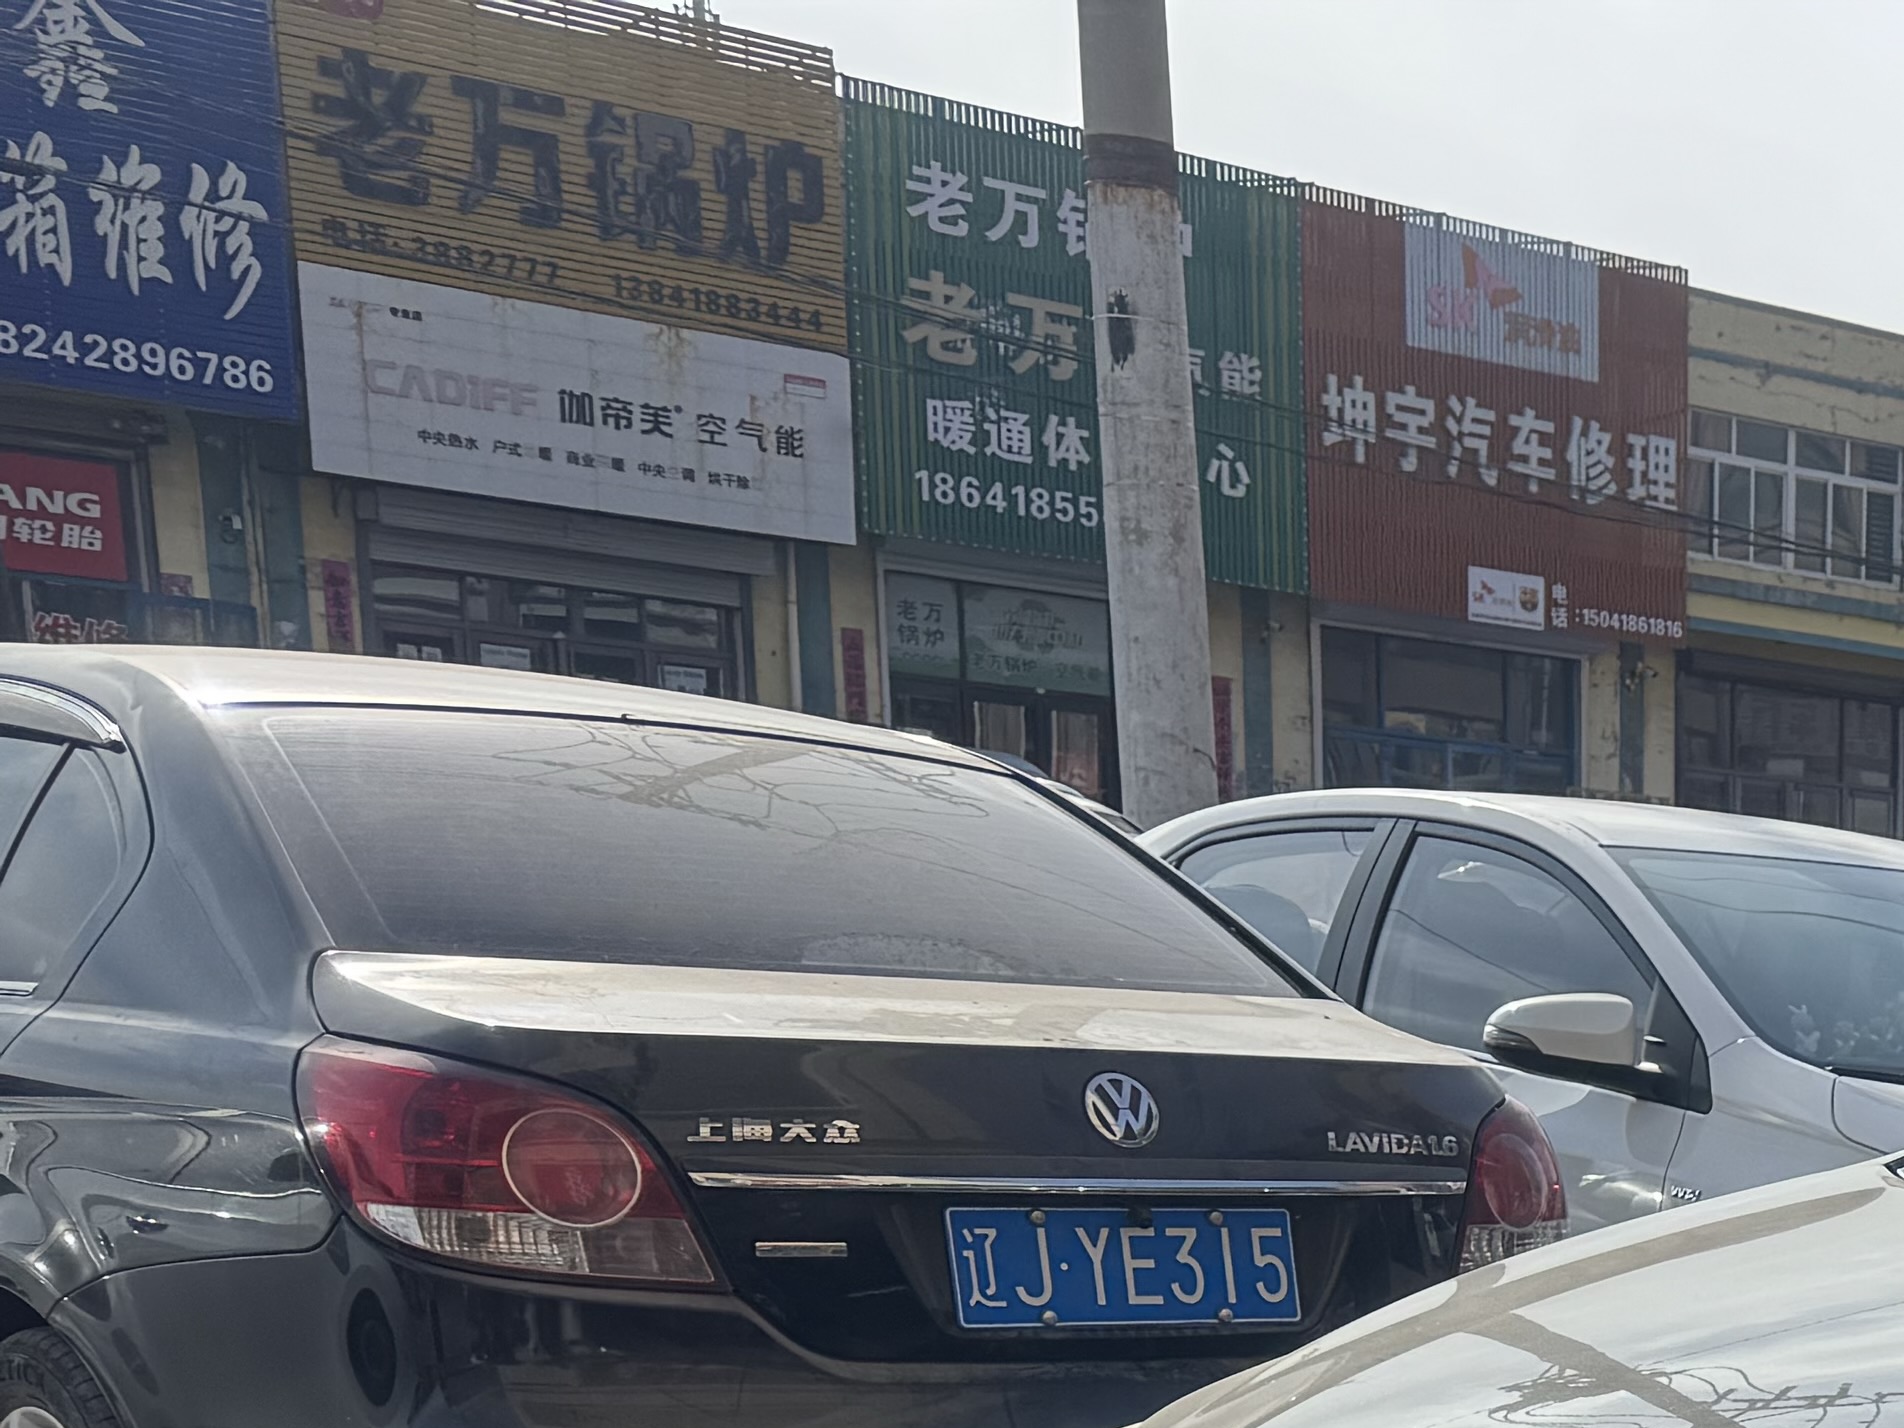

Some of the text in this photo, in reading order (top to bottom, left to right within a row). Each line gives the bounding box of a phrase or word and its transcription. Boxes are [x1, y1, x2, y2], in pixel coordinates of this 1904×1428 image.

[311, 47, 826, 269] 老万锅炉
[0, 130, 269, 321] 箱维修
[906, 160, 1193, 259] 老万
[696, 412, 804, 459] 空气能
[1321, 372, 1679, 512] 坤宇汽车修理
[914, 469, 1100, 528] 18641855
[0, 514, 103, 551] 轮胎
[686, 1116, 861, 1145] 上海大众
[1327, 1131, 1429, 1155] LAVIDA
